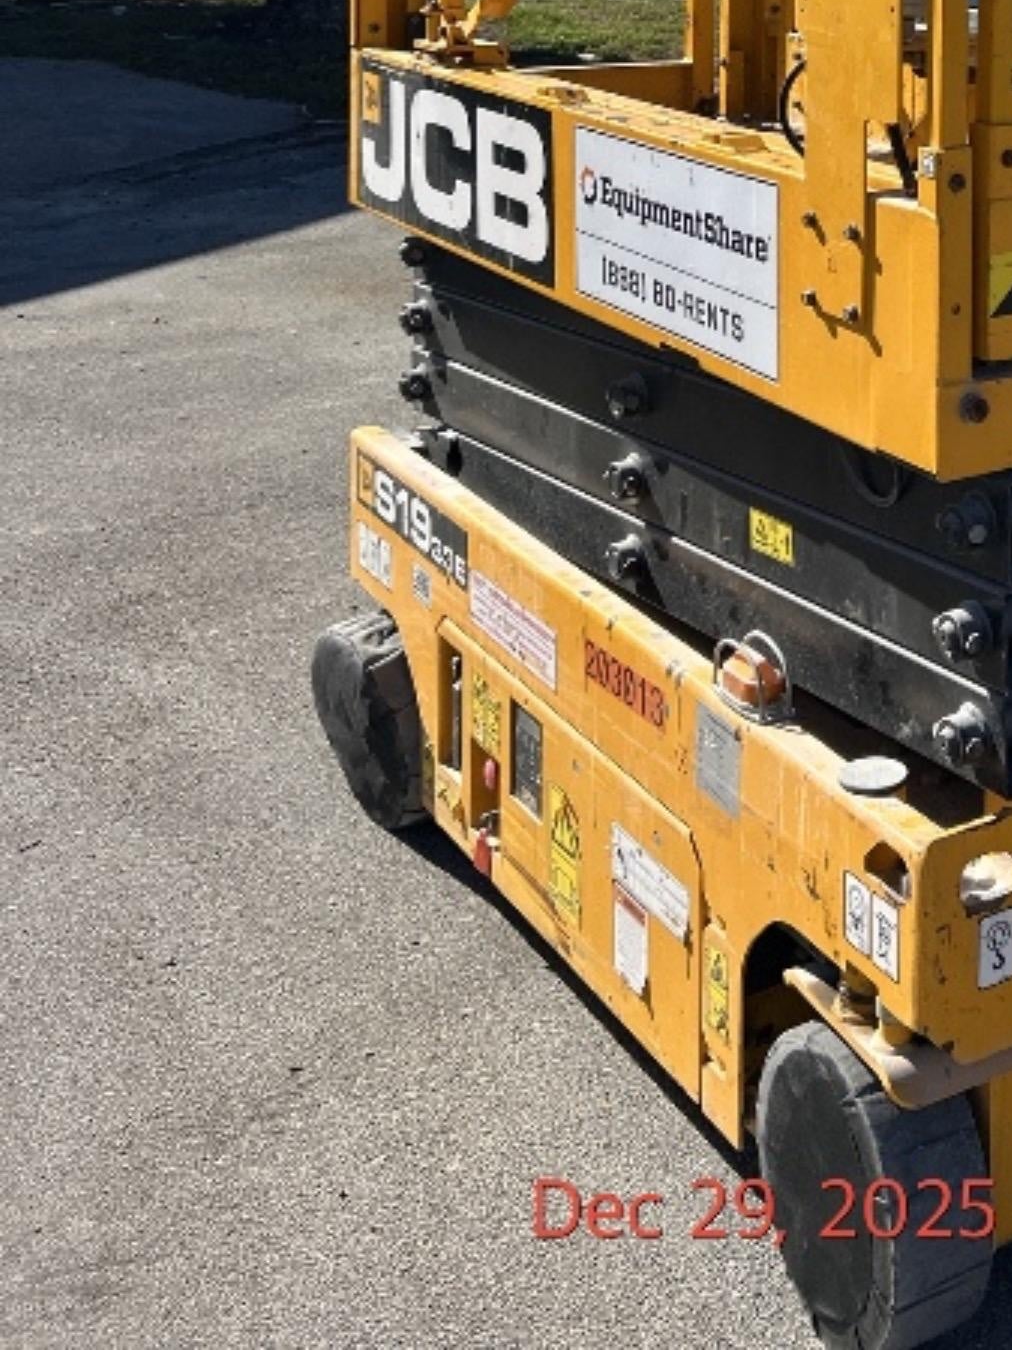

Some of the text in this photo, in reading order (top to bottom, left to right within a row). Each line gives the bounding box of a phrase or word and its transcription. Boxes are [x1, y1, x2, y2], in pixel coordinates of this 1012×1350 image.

[361, 78, 550, 264] JCB
[599, 175, 770, 263] EquipmentShare
[585, 638, 664, 727] 203013
